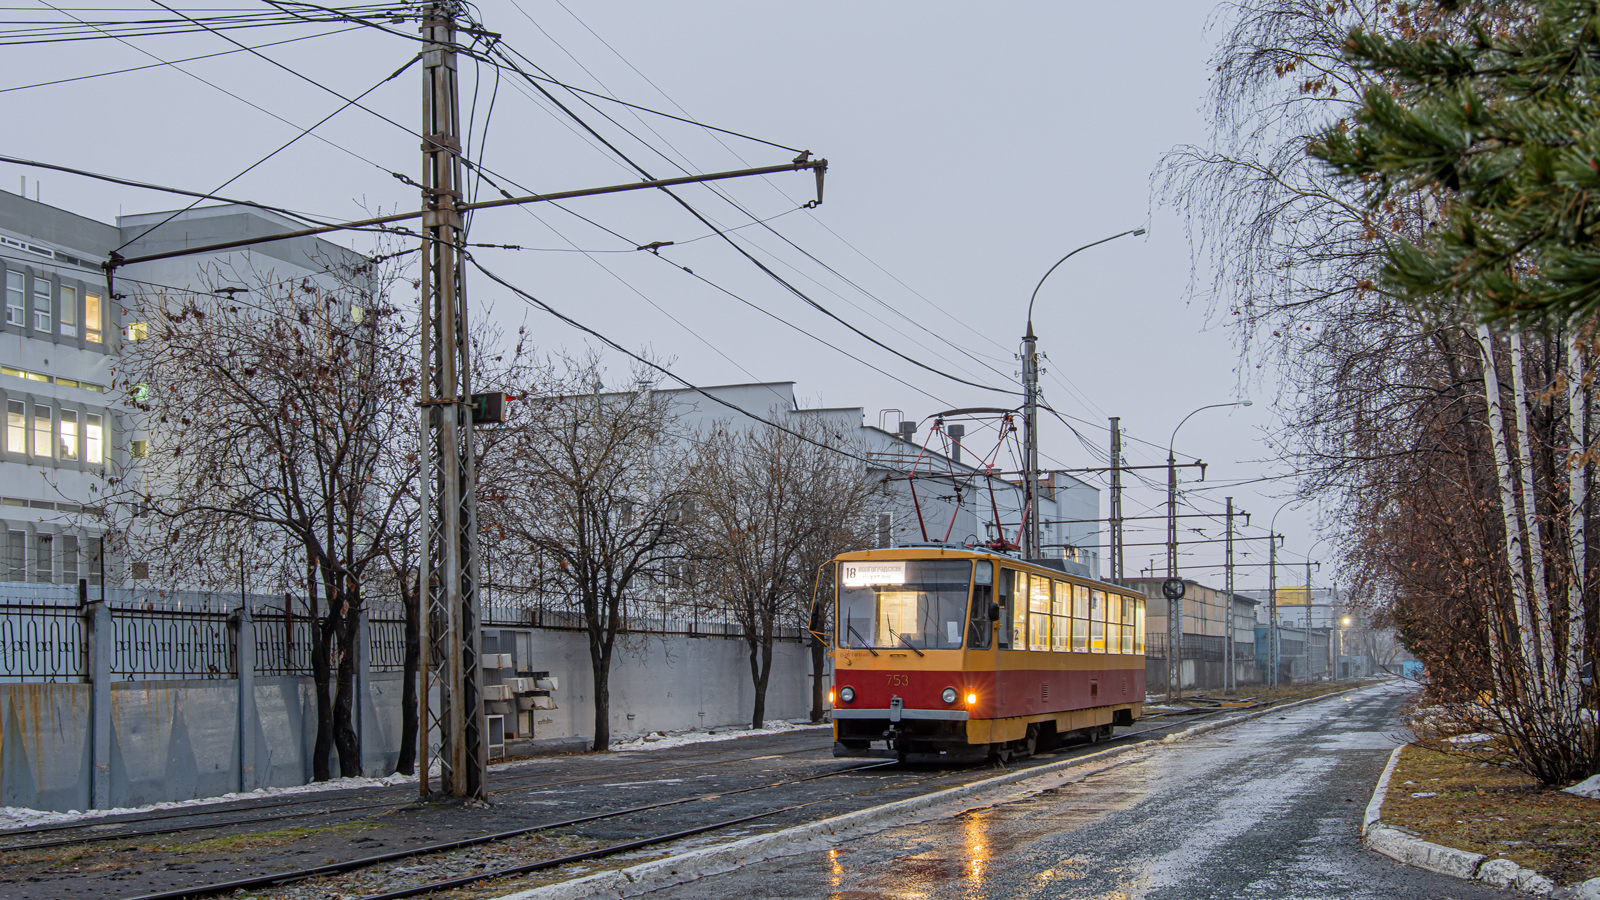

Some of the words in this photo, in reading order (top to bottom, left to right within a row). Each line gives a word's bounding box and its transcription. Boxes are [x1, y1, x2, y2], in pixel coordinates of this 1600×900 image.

[846, 567, 857, 579] 18
[1014, 629, 1019, 641] 2
[886, 674, 909, 687] 753
